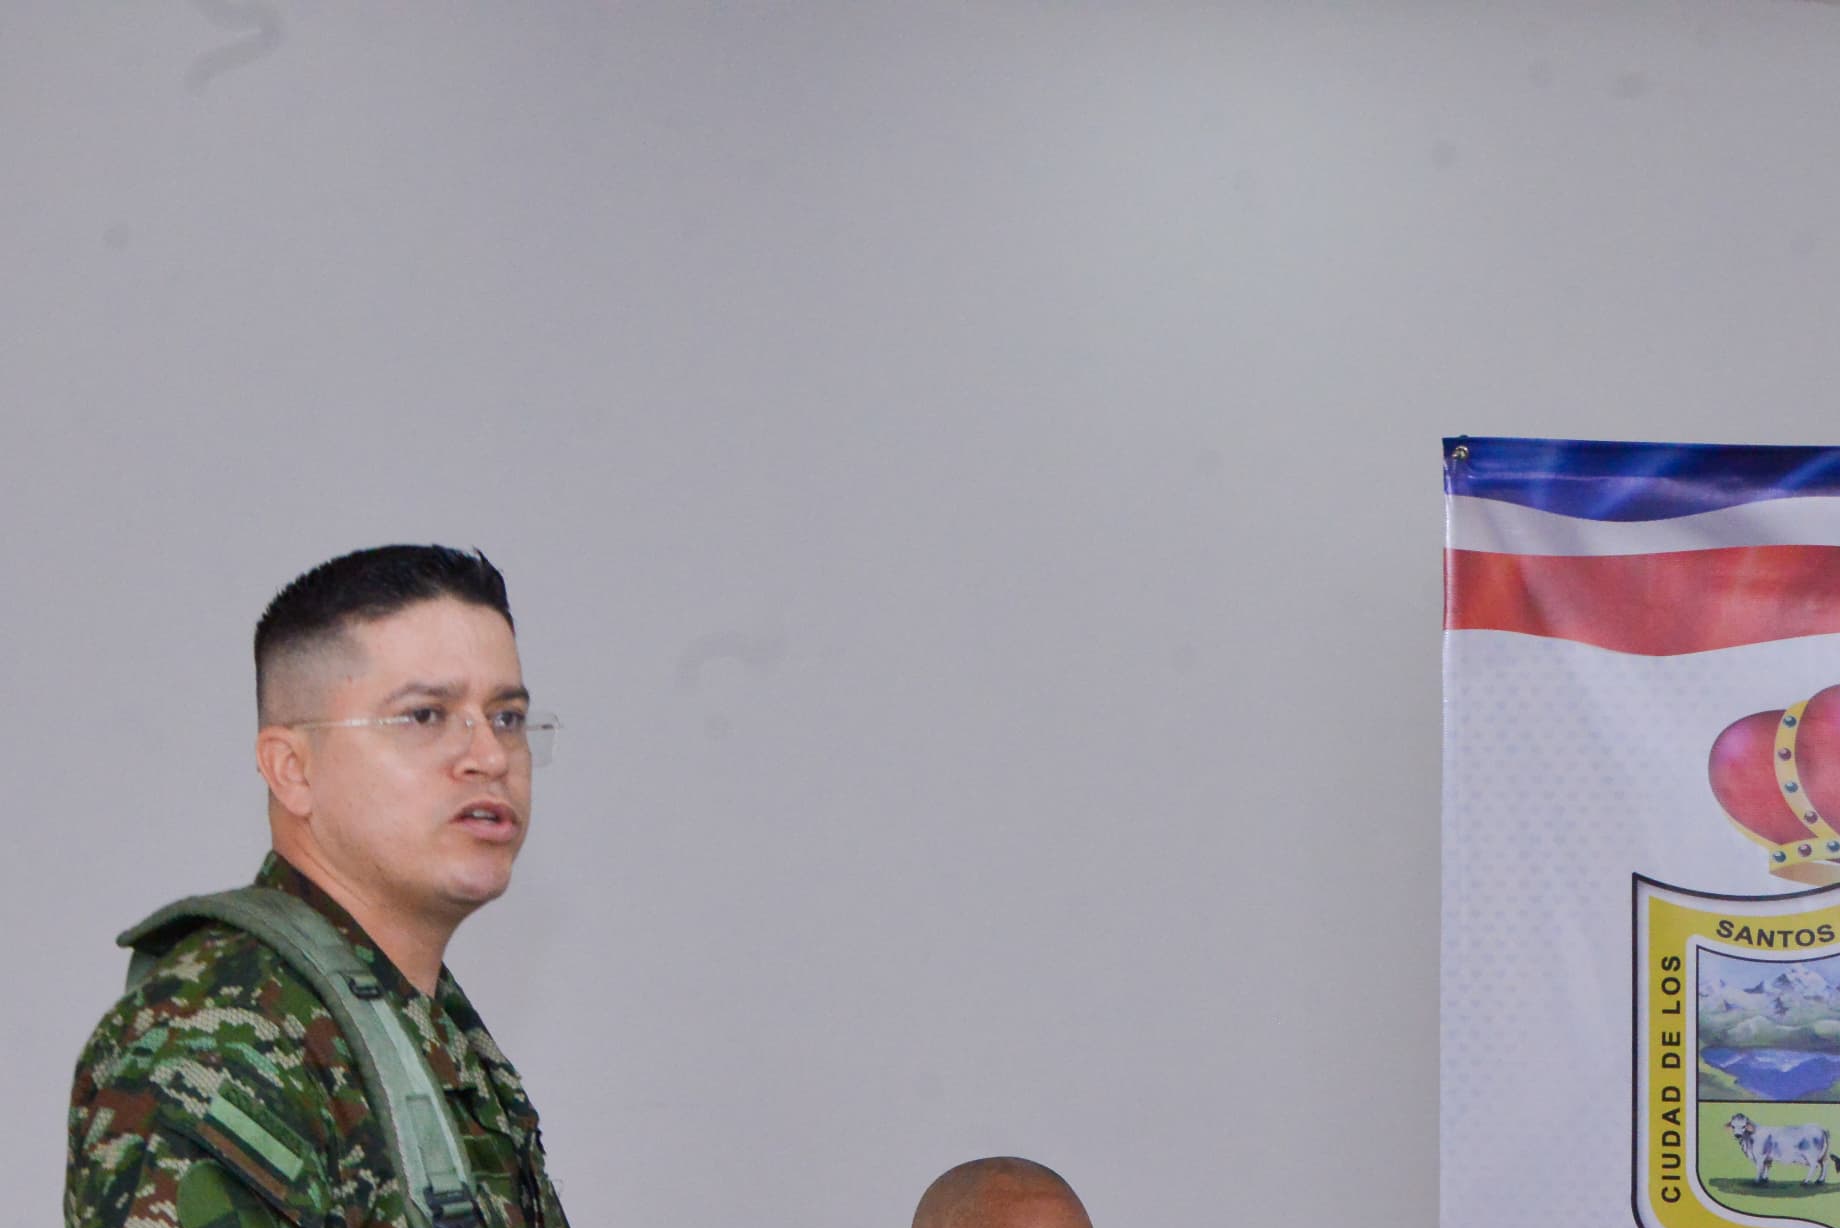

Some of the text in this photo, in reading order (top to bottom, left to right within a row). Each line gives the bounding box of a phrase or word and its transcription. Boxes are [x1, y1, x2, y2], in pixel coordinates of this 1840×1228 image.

[1716, 919, 1836, 948] SANTOS
[1661, 955, 1682, 1203] CIUDAD DE LOS
